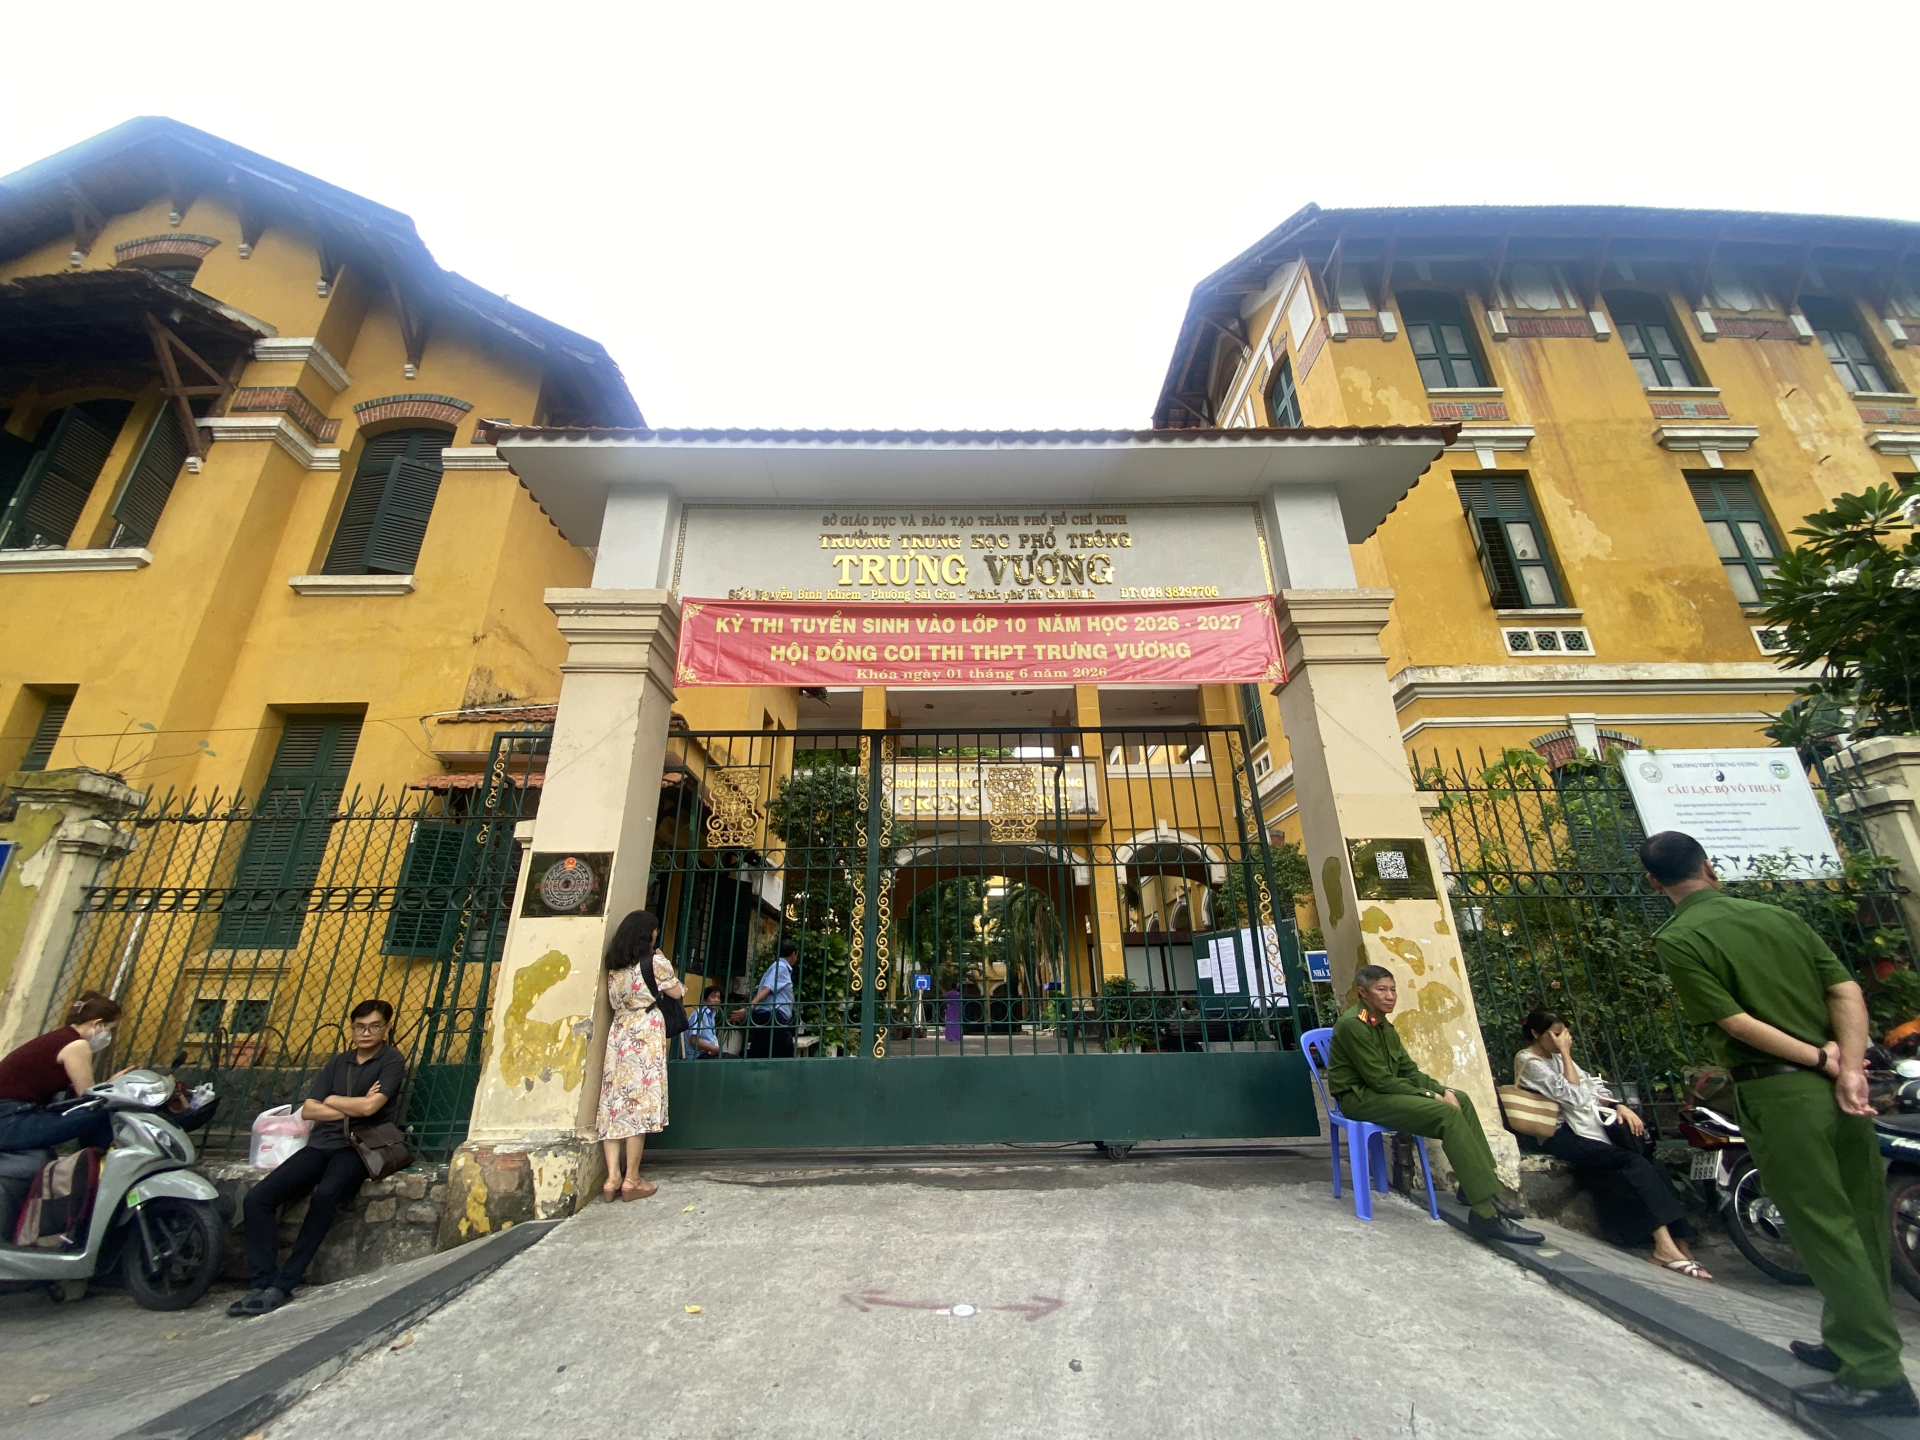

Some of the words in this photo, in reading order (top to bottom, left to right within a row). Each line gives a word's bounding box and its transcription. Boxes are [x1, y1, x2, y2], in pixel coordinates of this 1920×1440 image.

[822, 513, 838, 526] SỞ
[840, 514, 869, 526] GIÁO
[872, 516, 896, 528] DỤC
[901, 514, 917, 526] VÀ
[921, 514, 946, 526] ĐÀO
[950, 516, 974, 528] TẠO
[978, 513, 1019, 526] THÀNH
[1024, 513, 1047, 525] PHỐ
[1051, 511, 1067, 525] HỒ
[1071, 512, 1092, 525] CHÍ
[1096, 515, 1127, 525] MINH
[819, 529, 892, 549] TRƯỜNG
[898, 534, 962, 549] TRUNG
[971, 534, 1010, 553] HỌC
[1018, 525, 1057, 549] PHỔ
[1066, 529, 1132, 548] THÔNG
[833, 549, 969, 586] TRƯNG
[983, 549, 1115, 585] VƯƠNG
[728, 587, 744, 599] Số
[744, 588, 752, 599] 3
[754, 587, 793, 600] Nguyễn
[826, 589, 861, 600] Khiêm
[914, 588, 931, 600] Sài
[967, 588, 1001, 600] Thành
[1004, 588, 1025, 602] phố
[1027, 587, 1043, 600] Hồ
[1046, 588, 1065, 599] Chí
[1067, 588, 1096, 599] Minh
[1165, 586, 1219, 598] 38297706
[715, 613, 744, 633] KỲ
[750, 617, 783, 633] THI
[790, 610, 856, 633] TUYỂN
[862, 617, 909, 633] SINH
[915, 613, 956, 633] VÀO
[961, 613, 998, 633] LỚP
[1004, 617, 1026, 633] 10
[1037, 613, 1081, 632] NĂM
[1087, 616, 1128, 636] HỌC
[1134, 616, 1180, 631] 2026
[1196, 615, 1242, 630] 2027
[770, 642, 809, 666] HỘI
[815, 638, 877, 661] ĐỒNG
[883, 645, 921, 661] COI
[928, 645, 963, 661] THI
[971, 644, 1027, 660] THPT
[1033, 641, 1108, 660] TRƯNG
[1114, 640, 1191, 659] VƯƠNG
[856, 668, 897, 679] Khóa
[903, 669, 941, 681] ngày
[946, 669, 963, 679] 01
[969, 668, 1015, 680] tháng
[1019, 668, 1028, 679] 6
[1033, 668, 1068, 678] năm
[1072, 667, 1107, 677] 2026
[1667, 784, 1689, 794] CÂU
[1691, 785, 1712, 795] LẠC
[1714, 784, 1729, 795] BỘ
[1747, 783, 1782, 794] THUẬT
[898, 793, 980, 811] TRƯNG
